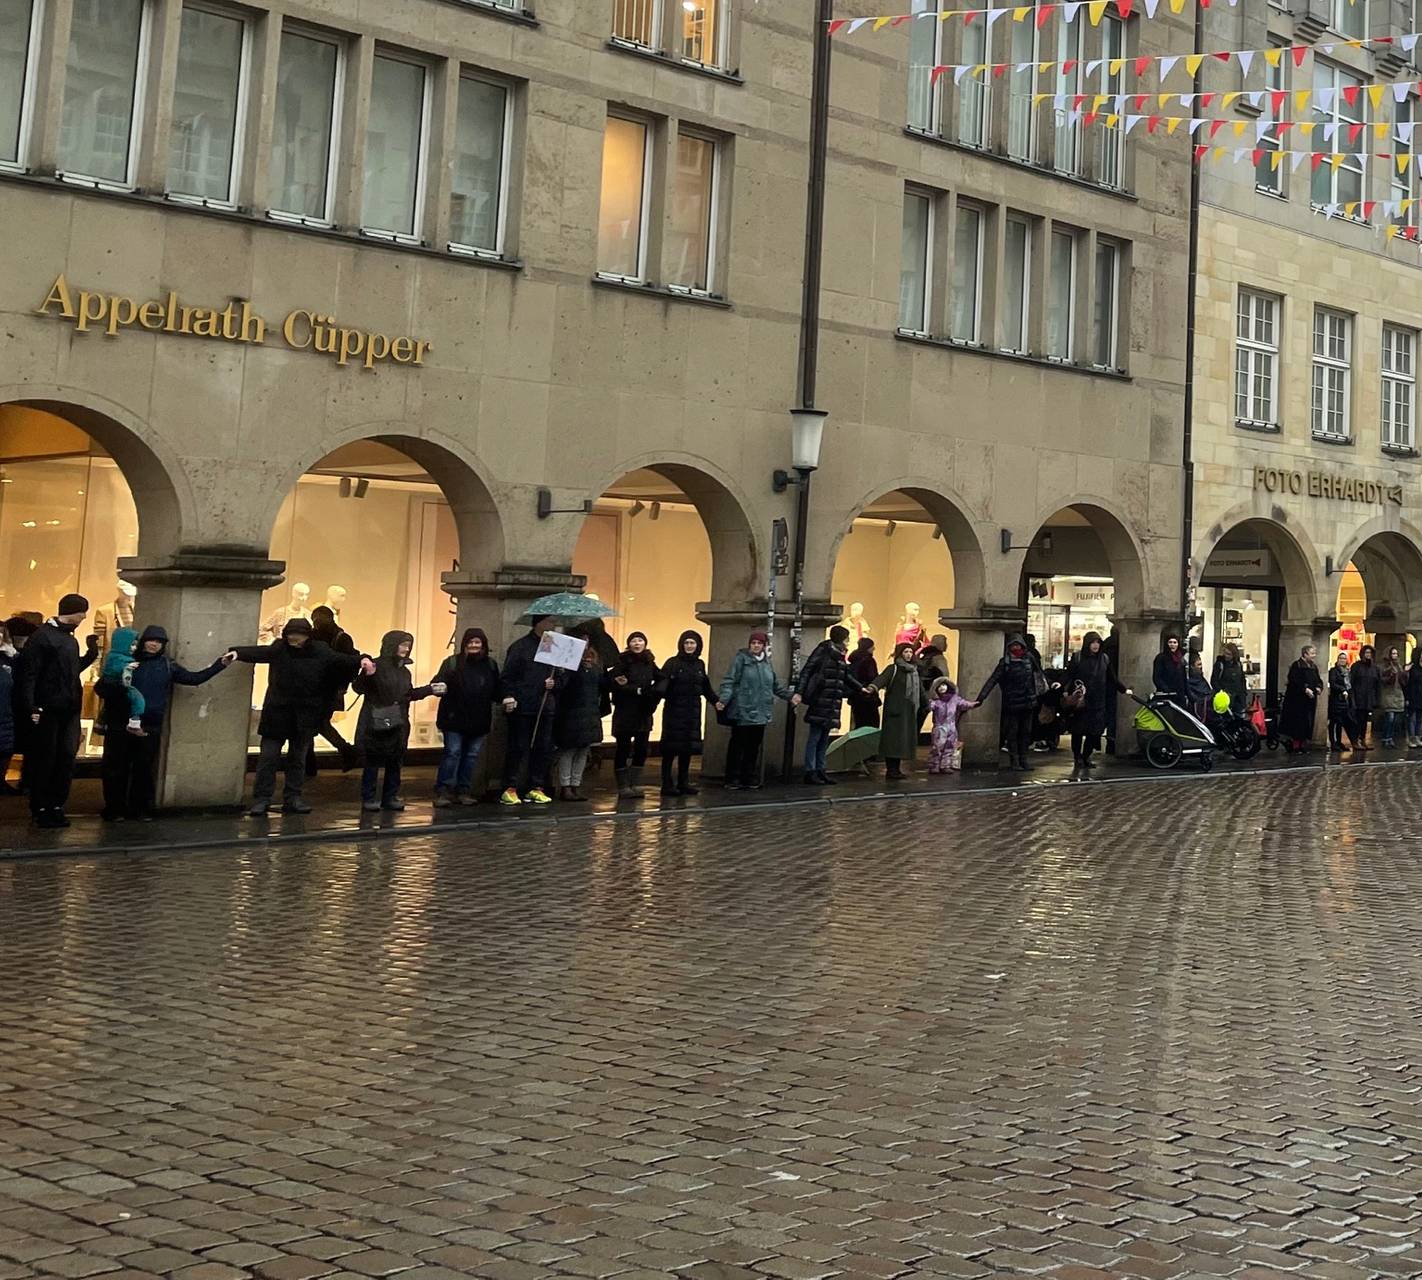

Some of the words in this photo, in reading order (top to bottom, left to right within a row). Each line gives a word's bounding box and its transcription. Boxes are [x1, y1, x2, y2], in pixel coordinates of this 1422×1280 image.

[38, 273, 265, 343] Appelrath
[284, 309, 432, 368] Cüpper
[1253, 466, 1302, 496] FOTO
[1307, 471, 1385, 505] ERHARDT
